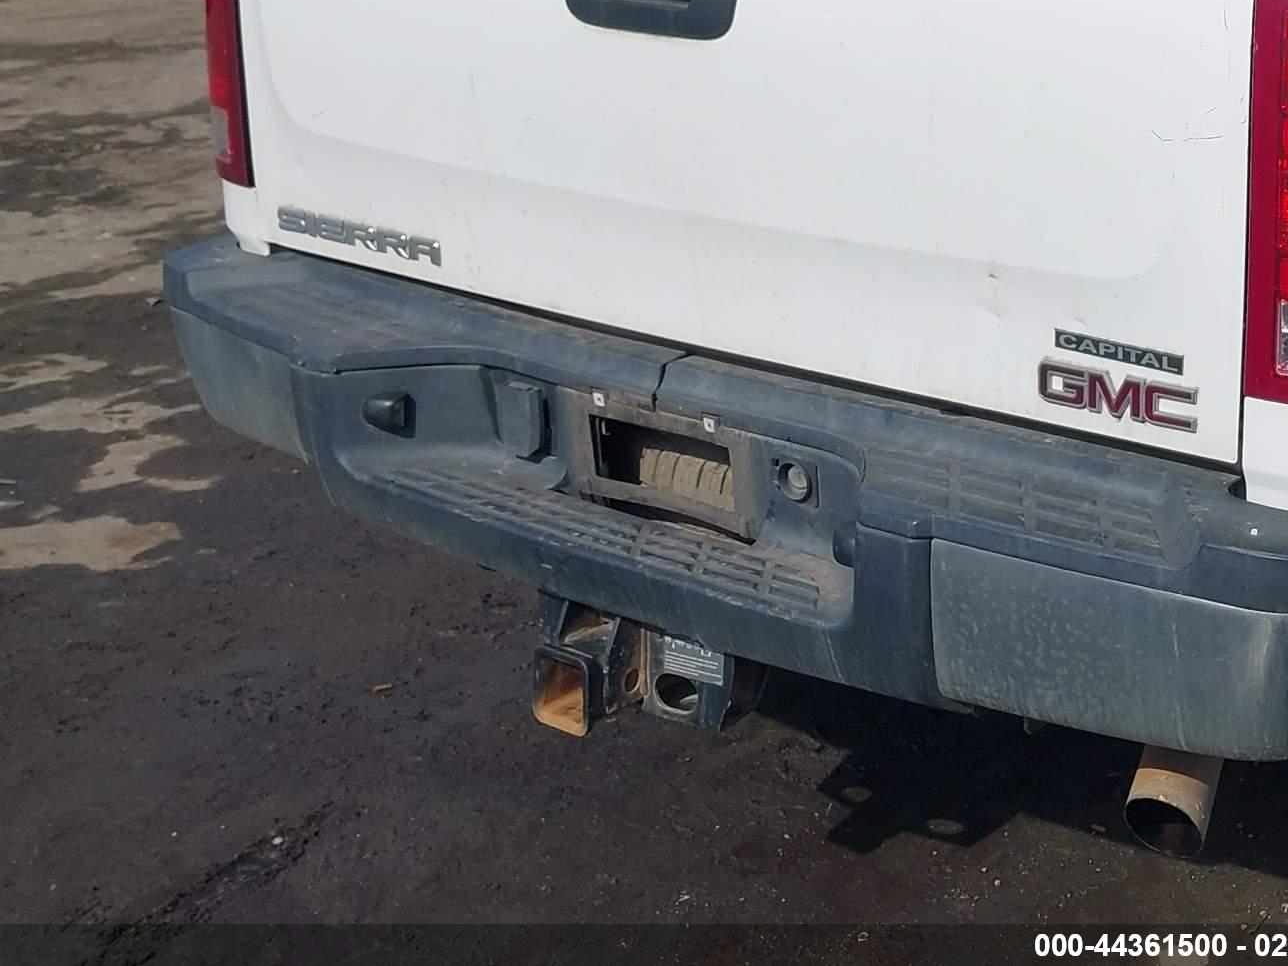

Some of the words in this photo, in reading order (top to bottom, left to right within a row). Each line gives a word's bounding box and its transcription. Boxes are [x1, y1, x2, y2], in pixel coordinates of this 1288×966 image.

[278, 207, 442, 267] SIERRA
[1057, 333, 1180, 373] CAPITAL
[1038, 357, 1199, 434] GMC
